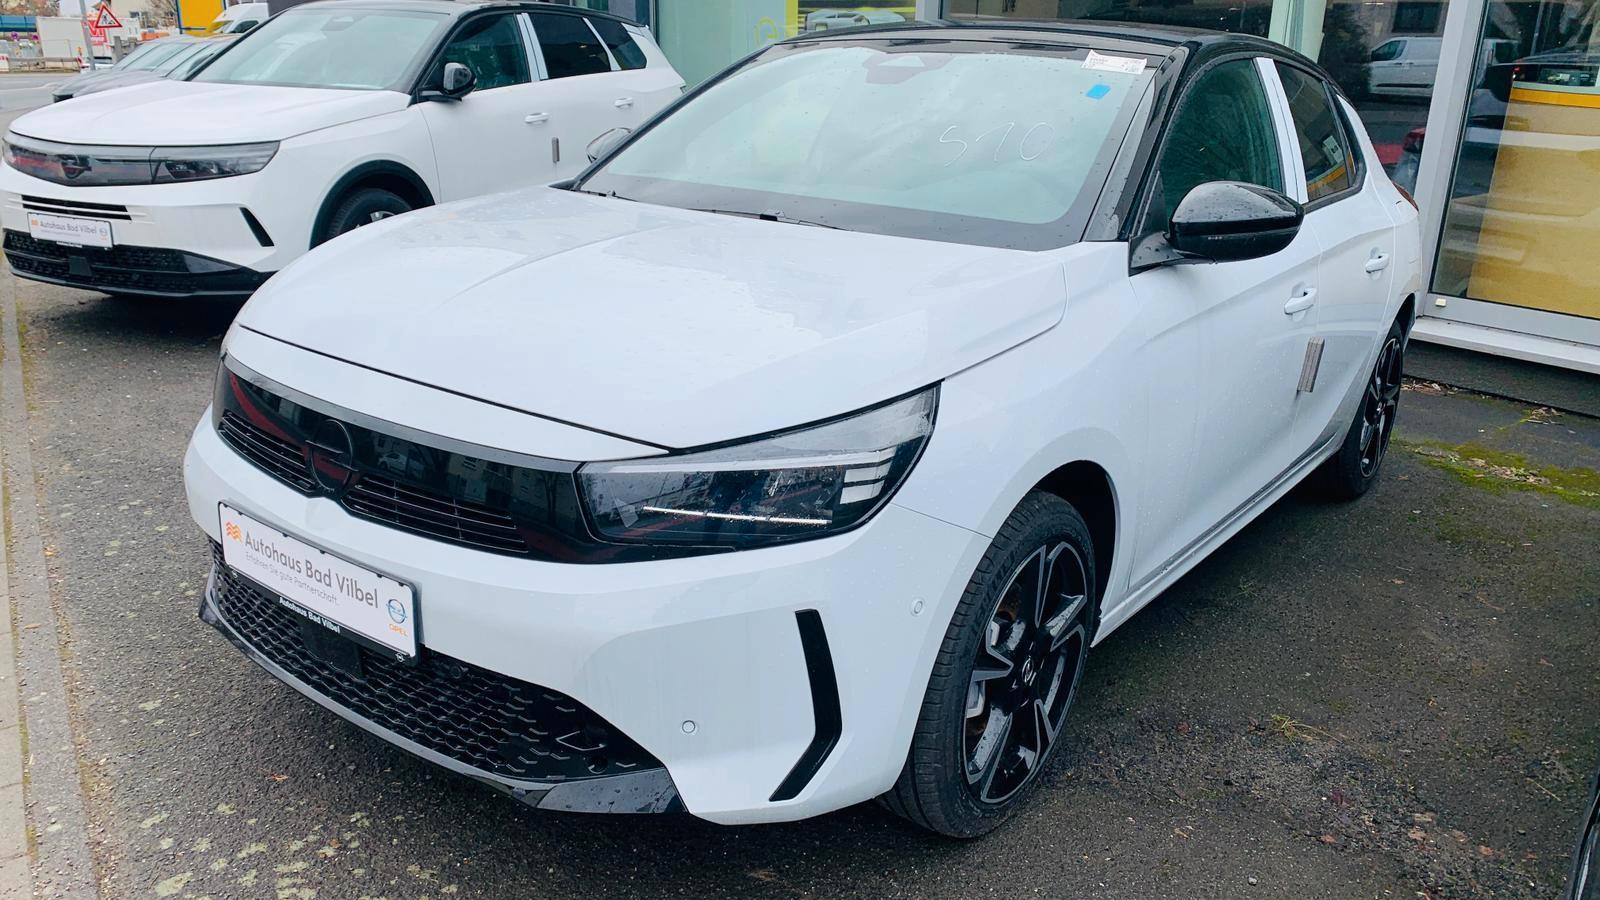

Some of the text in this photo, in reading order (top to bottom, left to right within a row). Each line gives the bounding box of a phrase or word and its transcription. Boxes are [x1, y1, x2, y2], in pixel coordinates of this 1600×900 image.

[40, 220, 66, 231] Autohaus
[67, 223, 79, 232] Bad
[244, 530, 379, 609] Autohaus Bad Vilbel
[279, 596, 341, 634] Autohaus Bad Vilbel
[388, 623, 408, 637] OPEL
